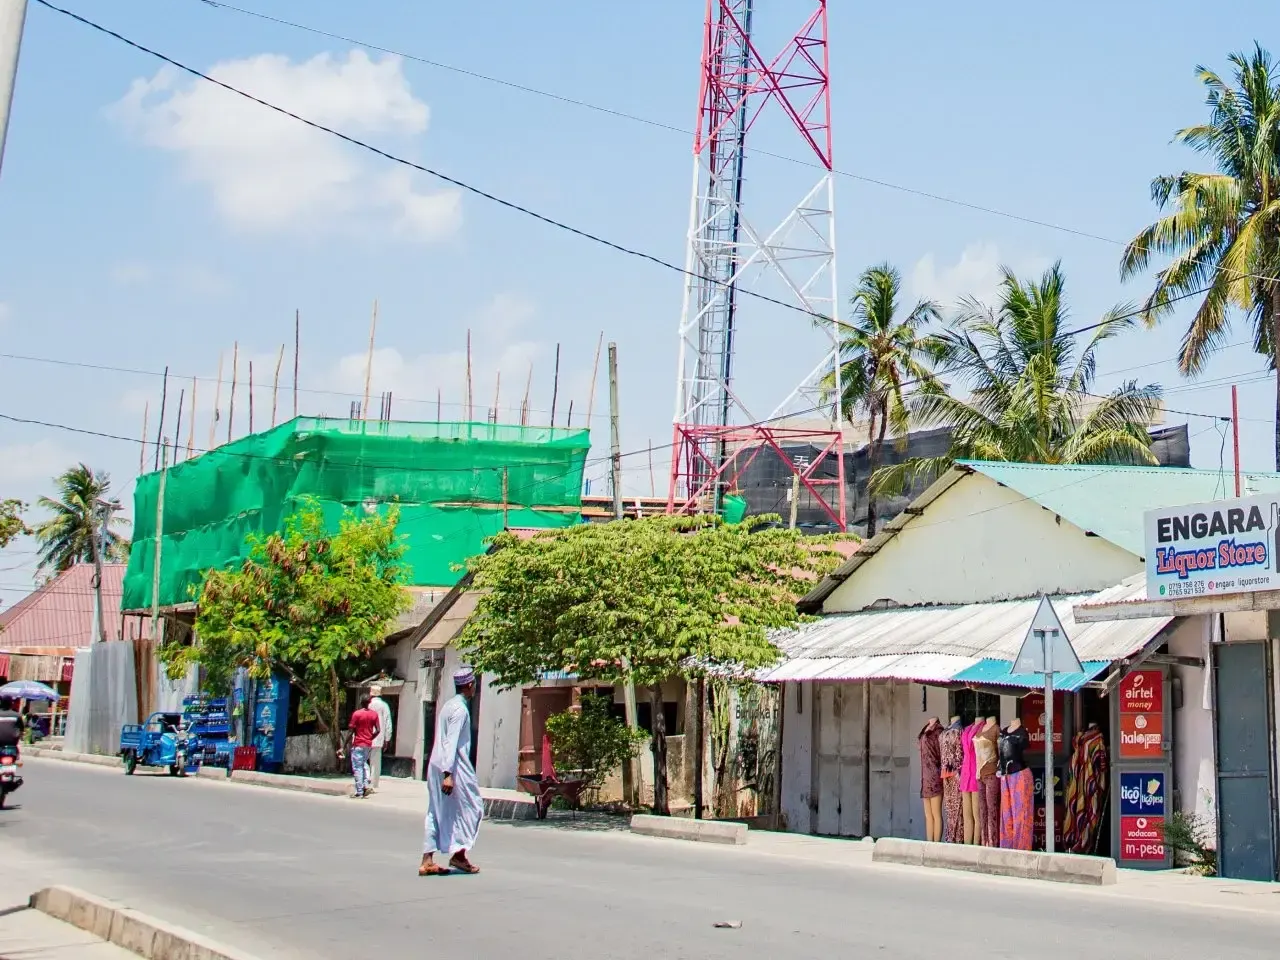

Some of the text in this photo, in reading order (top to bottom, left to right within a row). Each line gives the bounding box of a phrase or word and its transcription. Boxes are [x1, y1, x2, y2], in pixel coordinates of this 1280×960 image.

[1157, 505, 1265, 543] ENGARA
[1157, 538, 1267, 579] Liquor Store
[1125, 687, 1153, 698] airtel
[1127, 702, 1152, 710] money
[1128, 829, 1157, 837] vodacom
[1126, 843, 1164, 857] m-pesa
